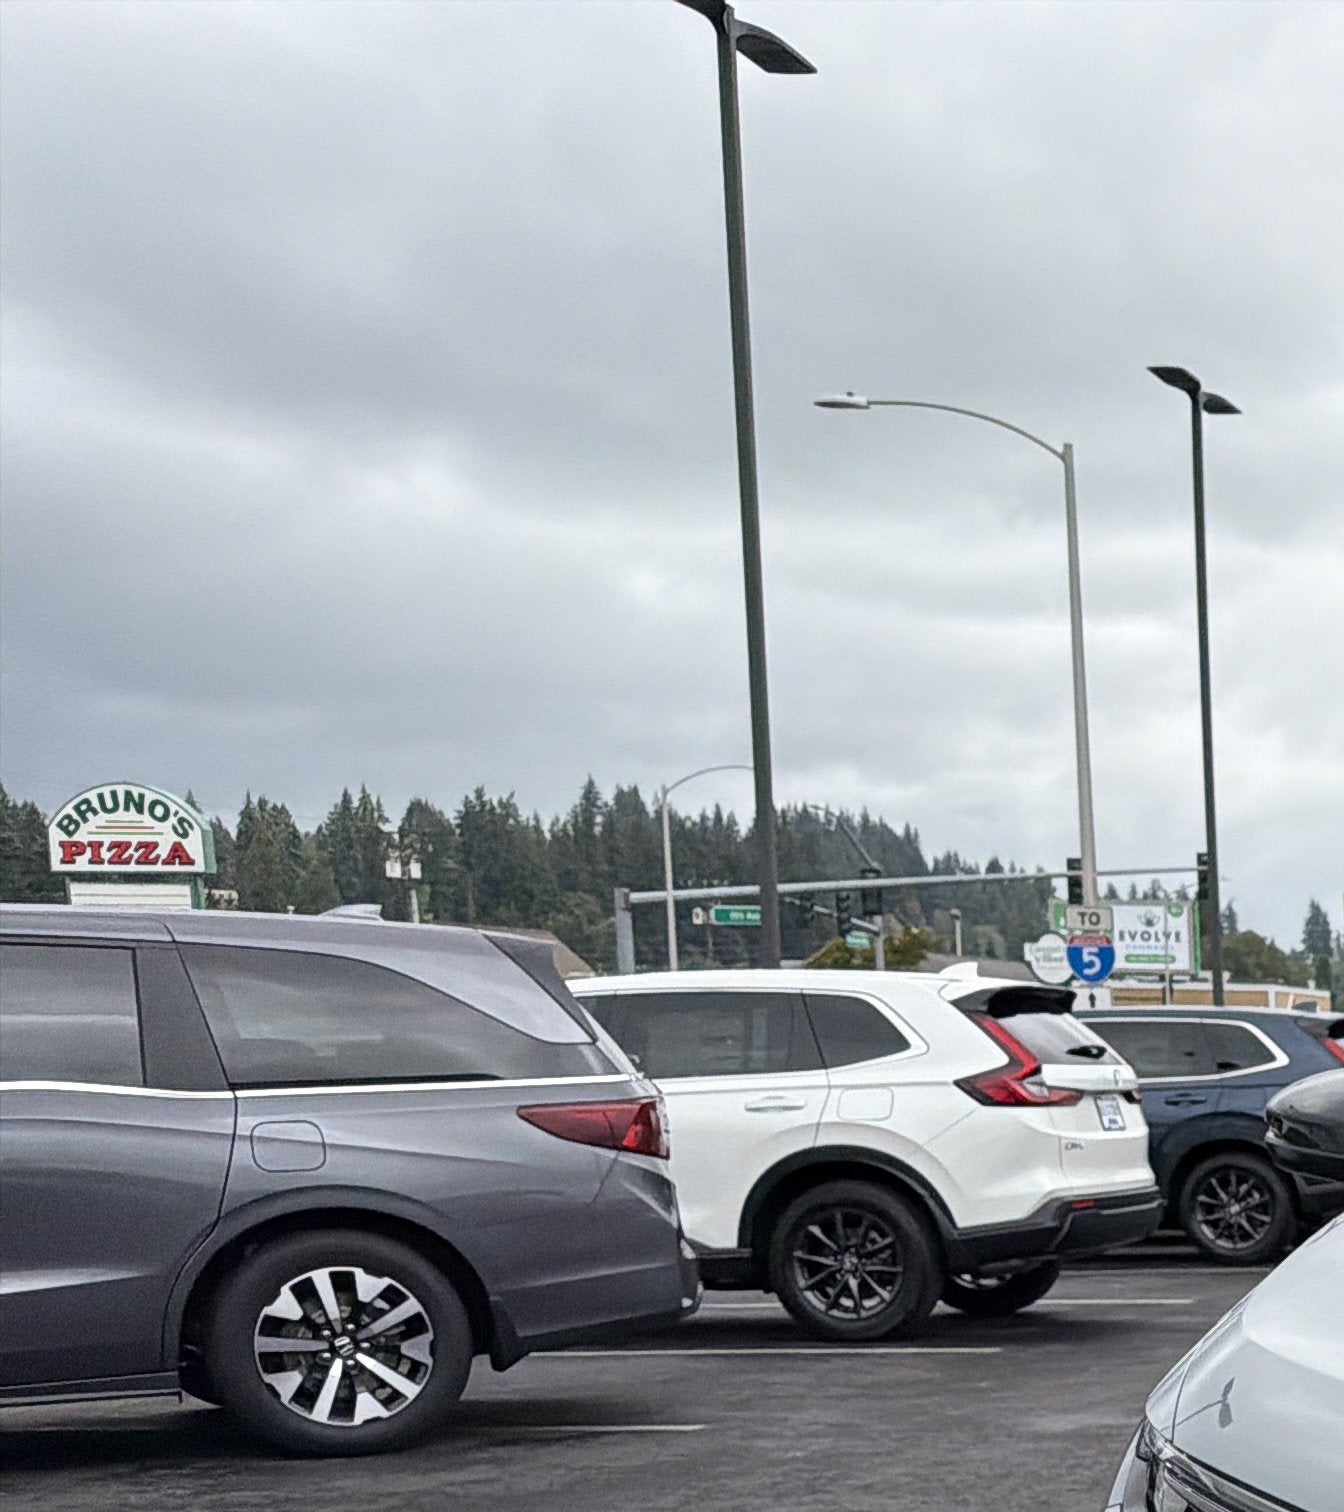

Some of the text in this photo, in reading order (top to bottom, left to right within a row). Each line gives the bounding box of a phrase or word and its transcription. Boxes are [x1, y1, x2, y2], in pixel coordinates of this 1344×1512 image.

[55, 789, 195, 840] BRUNO'S
[58, 840, 196, 866] PIZZA
[1077, 911, 1101, 926] TO
[1118, 930, 1181, 943] EVOLVE
[1081, 947, 1103, 976] 5
